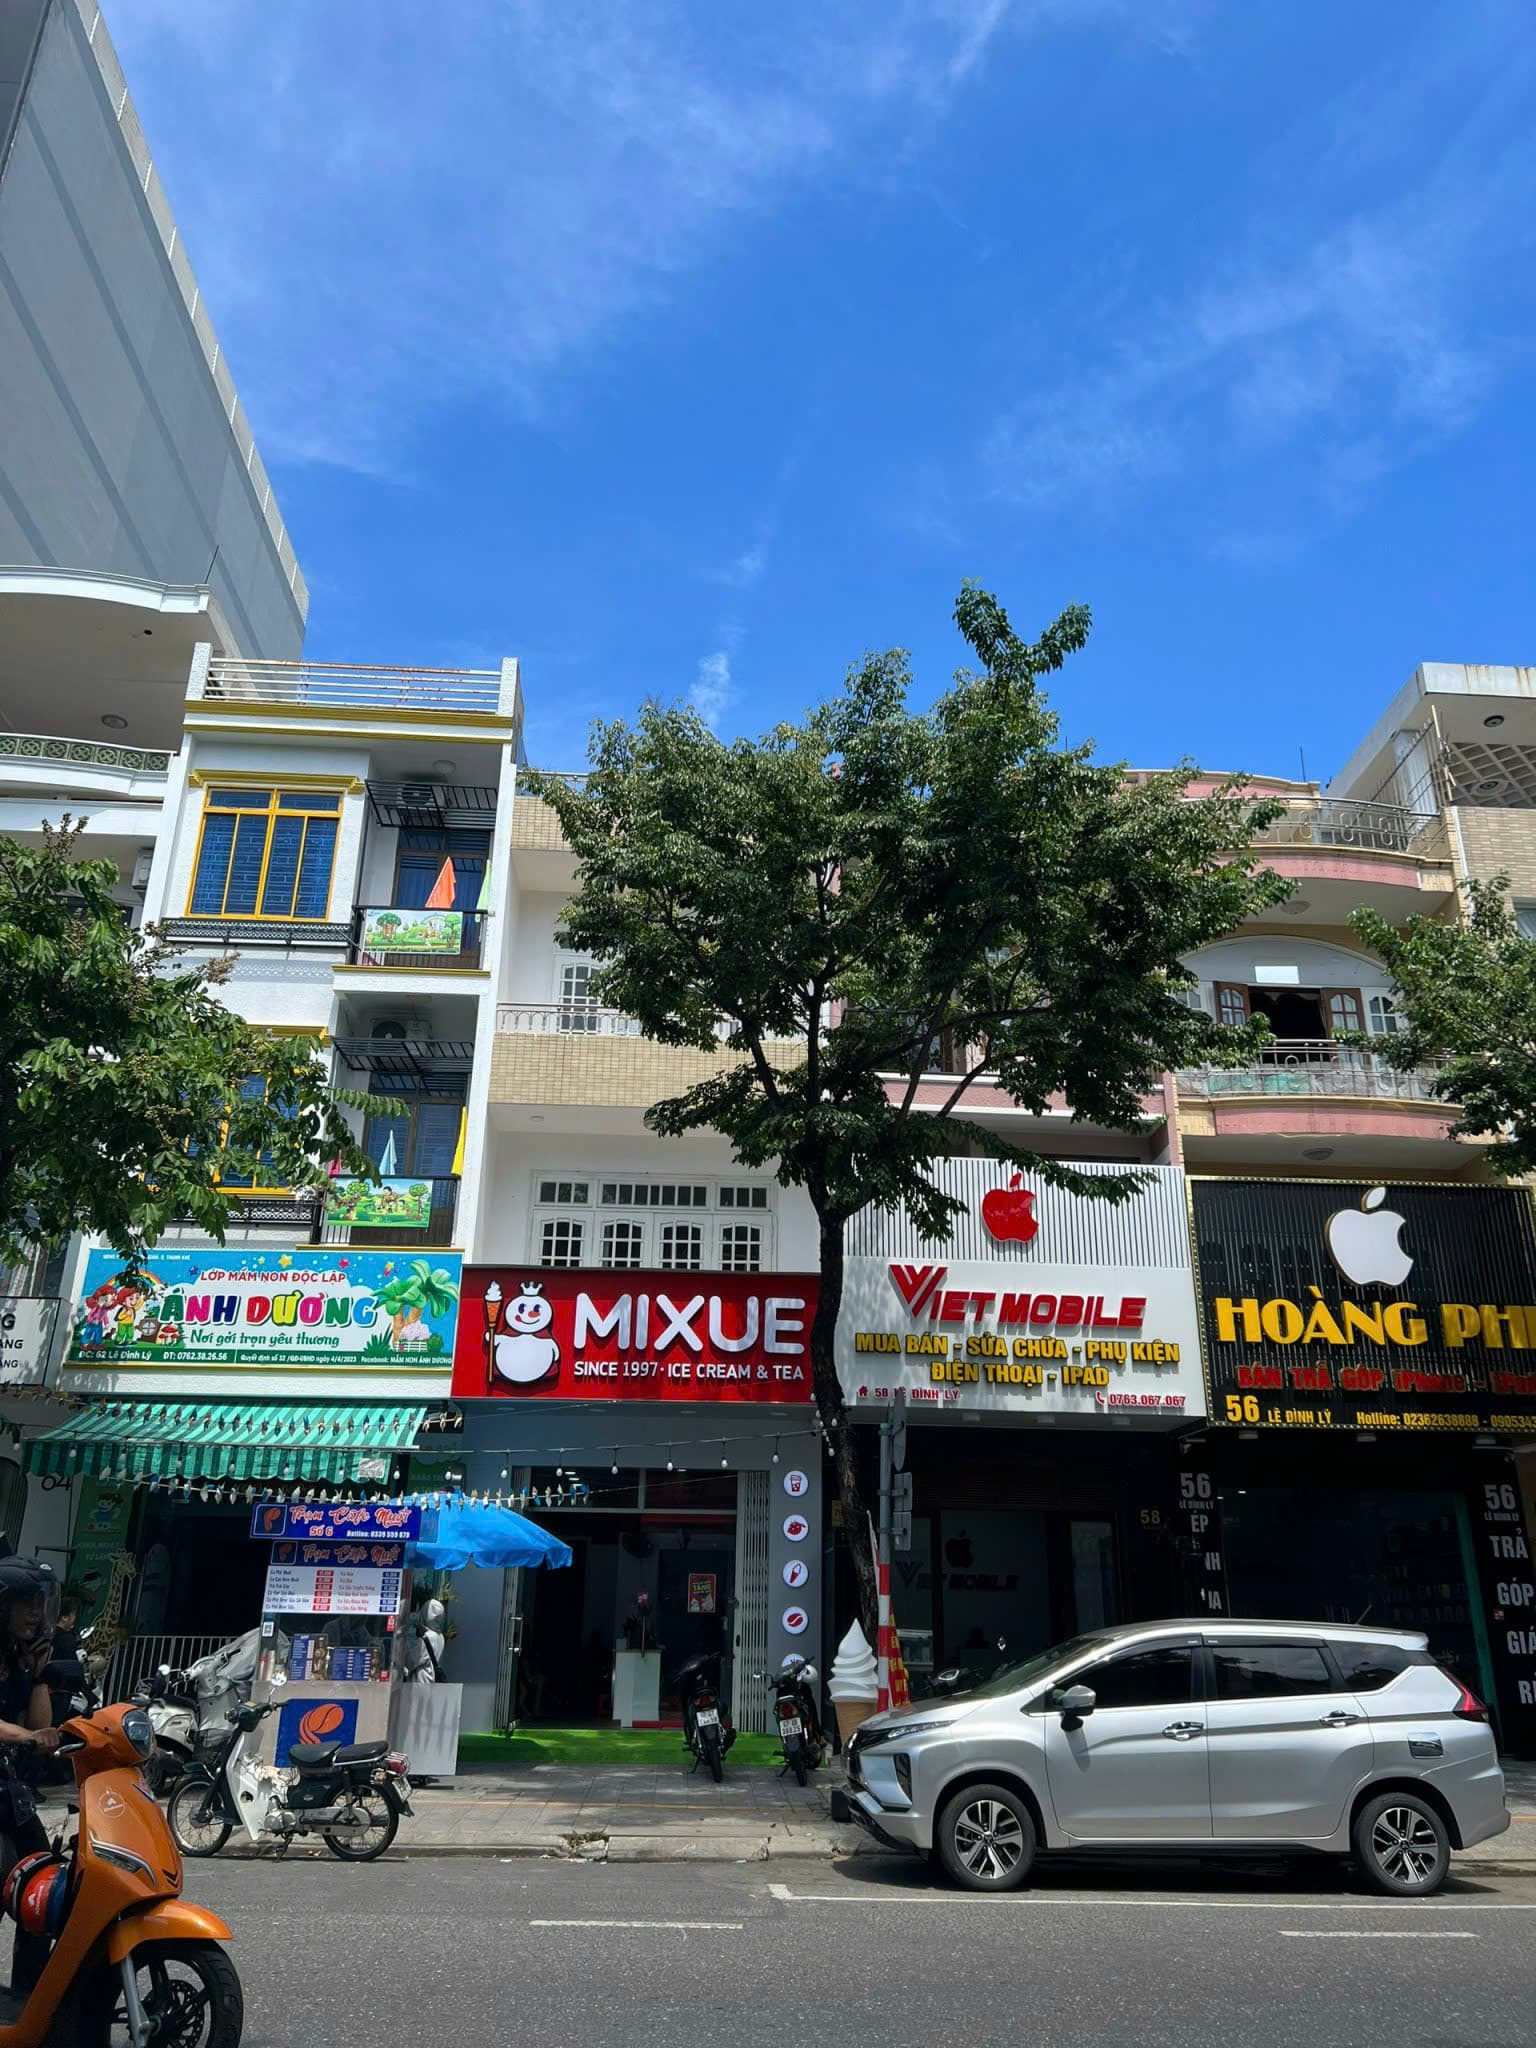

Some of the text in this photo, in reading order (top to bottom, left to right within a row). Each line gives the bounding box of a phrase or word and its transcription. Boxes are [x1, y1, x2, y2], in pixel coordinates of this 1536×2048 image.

[200, 1269, 226, 1281] LỚP
[261, 1271, 289, 1282] NON
[292, 1270, 318, 1285] ĐỘC
[321, 1270, 346, 1285] LẬP
[246, 1290, 376, 1326] DƯƠNG
[999, 1293, 1147, 1328] MOBILE
[1216, 1285, 1429, 1346] HOÀNG
[573, 1292, 806, 1354] MIXUE
[190, 1328, 213, 1343] Nơi
[240, 1332, 266, 1347] trọn
[269, 1333, 293, 1347] yêu
[296, 1332, 340, 1347] thương
[855, 1333, 900, 1354] MUA
[905, 1332, 948, 1355] BÁN
[967, 1331, 1009, 1358] SỬA
[1013, 1335, 1068, 1360] CHỮA
[1086, 1341, 1128, 1365] PHỤ
[1132, 1339, 1181, 1367] KIỆN
[141, 1351, 152, 1361] Lý
[573, 1361, 805, 1381] SINCE 1997 ICE CREAM & TEA
[930, 1360, 979, 1387] ĐIỆN
[983, 1363, 1044, 1389] THOẠI
[1062, 1366, 1111, 1387] IPAD
[1235, 1361, 1284, 1391] BÁN
[1289, 1360, 1334, 1392] TRẢ
[1339, 1363, 1386, 1392] GÓP
[874, 1387, 889, 1398] 58
[911, 1386, 940, 1400] ĐÌNH
[943, 1386, 960, 1400] LÝ
[1109, 1393, 1186, 1407] 0763.067.067
[1226, 1395, 1332, 1425] 56 LÊ ĐÌNH LÝ
[1356, 1410, 1401, 1426] Hotline:
[1179, 1472, 1212, 1499] 56
[1483, 1484, 1517, 1511] 56
[1139, 1509, 1161, 1525] 58
[1489, 1527, 1529, 1560] TRẢ
[1496, 1576, 1535, 1608] GÓP
